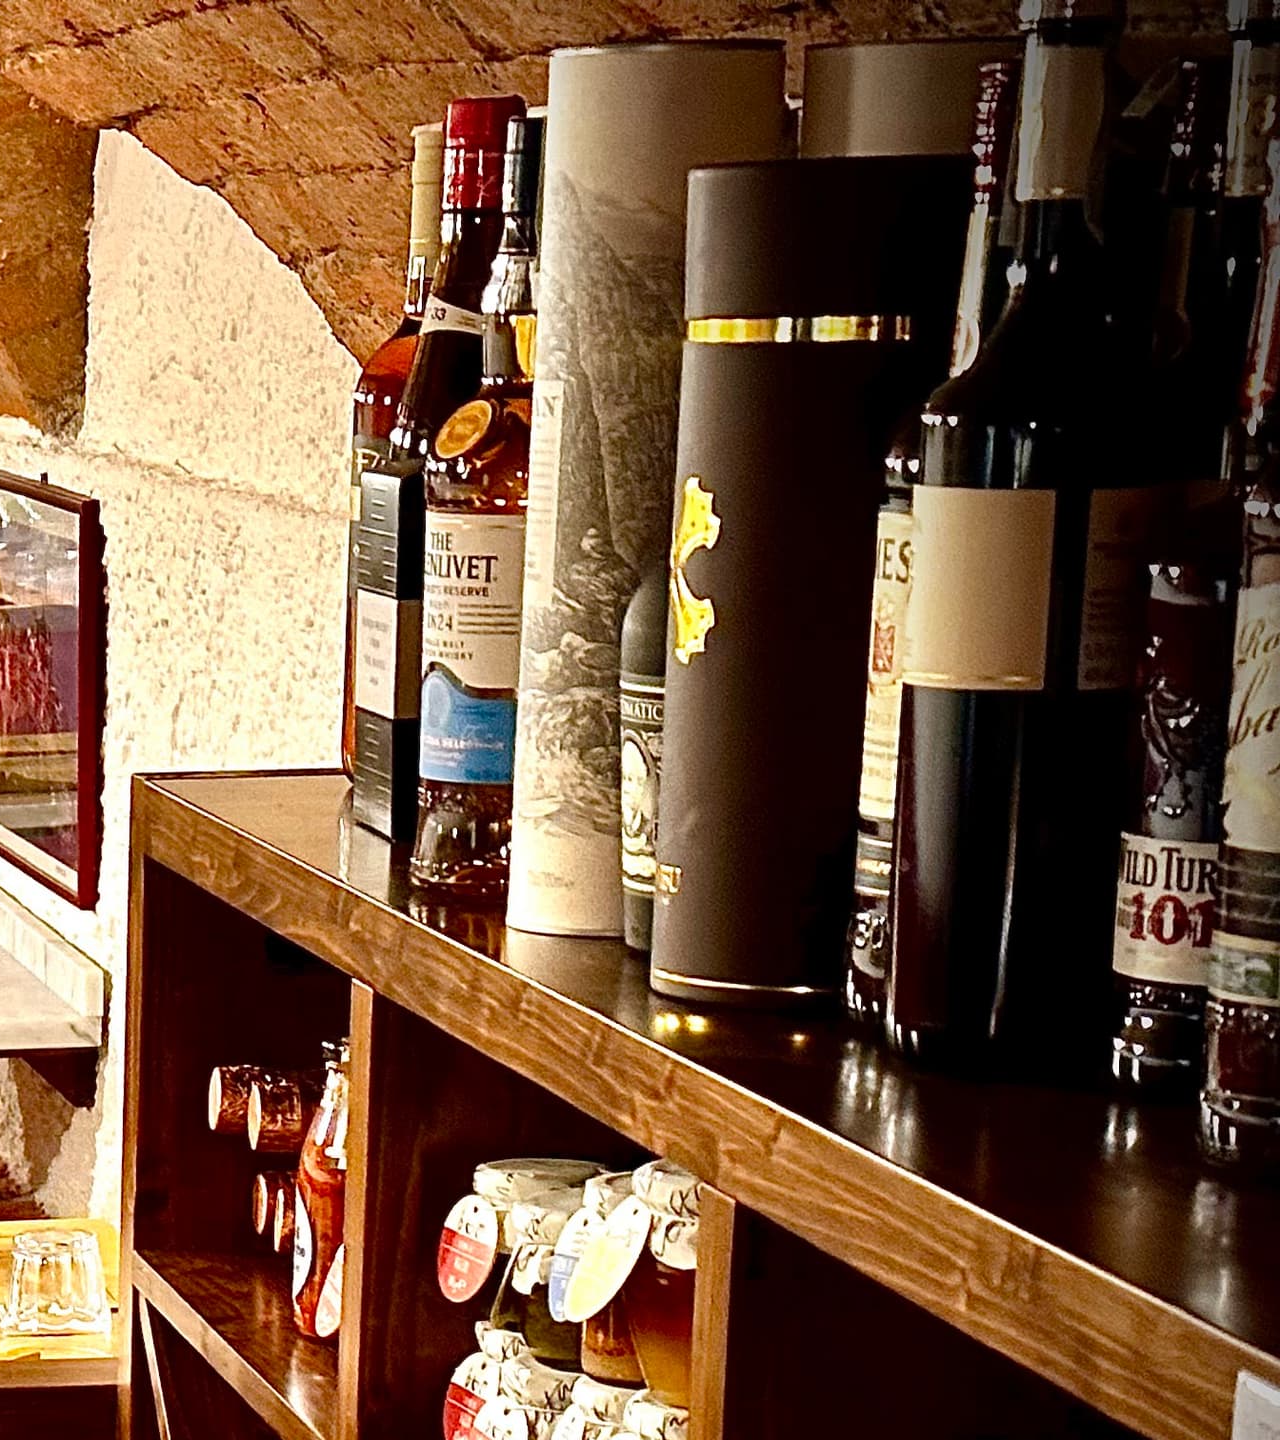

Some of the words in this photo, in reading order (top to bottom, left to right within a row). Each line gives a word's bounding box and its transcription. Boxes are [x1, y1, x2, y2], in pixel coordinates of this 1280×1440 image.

[431, 532, 453, 551] THE
[877, 538, 912, 584] ES
[1129, 892, 1214, 948] 101
